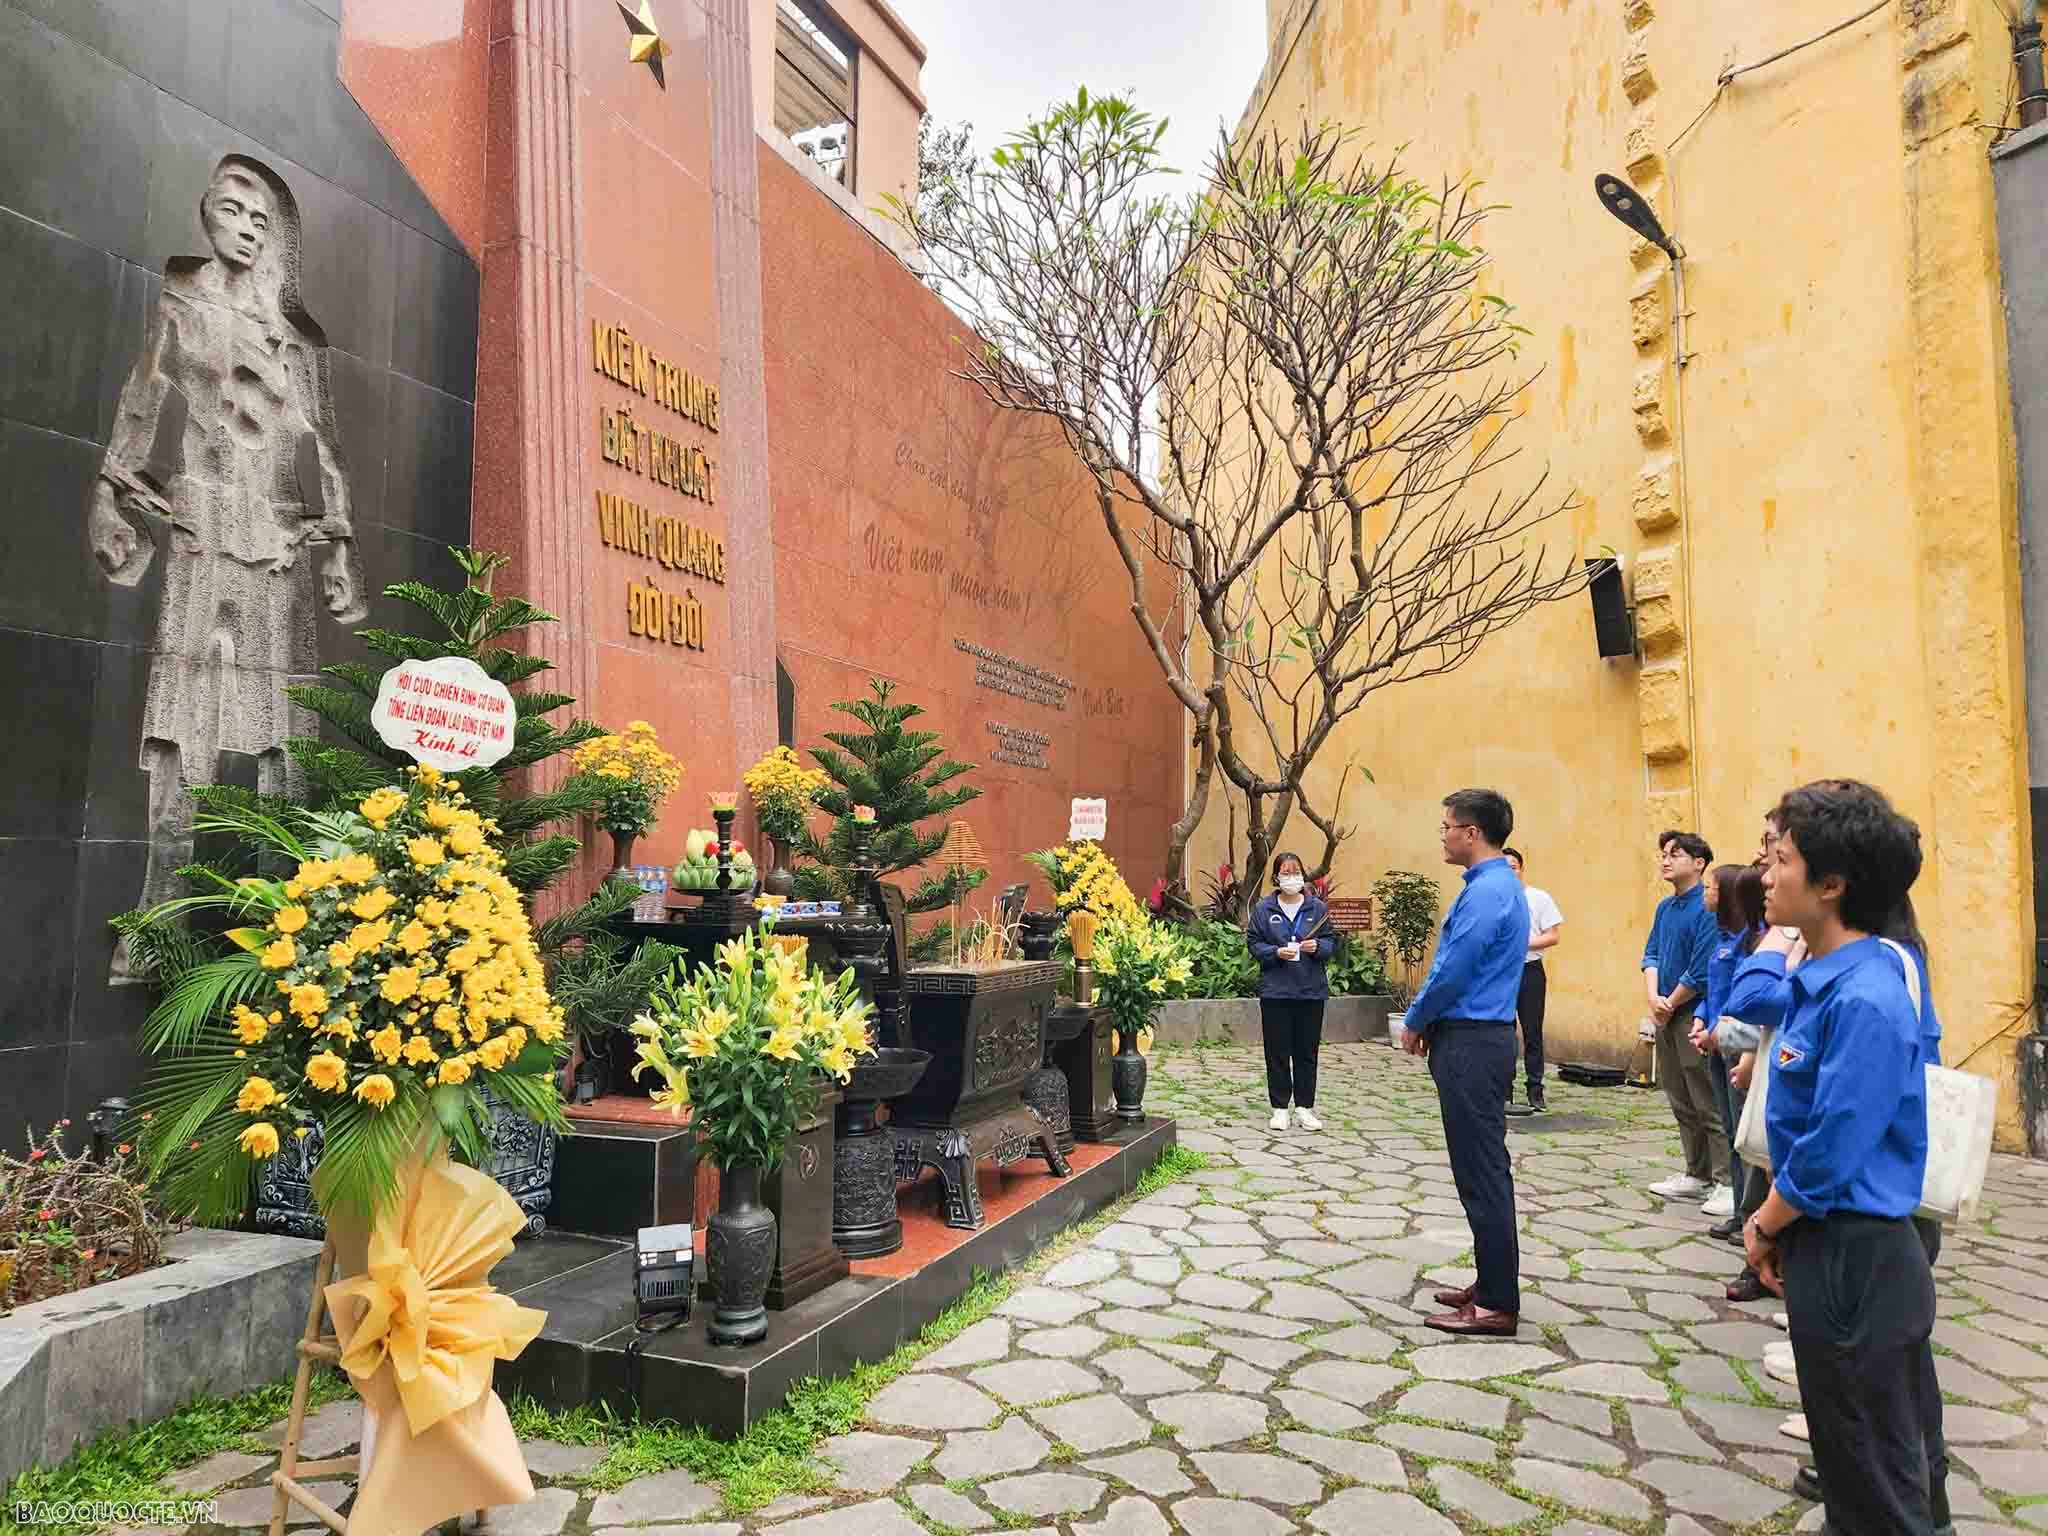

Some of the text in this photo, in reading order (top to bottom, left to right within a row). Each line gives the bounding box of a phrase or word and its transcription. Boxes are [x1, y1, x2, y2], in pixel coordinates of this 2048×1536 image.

[592, 319, 721, 434] KIÊN TRUNG
[600, 400, 718, 506] BẤT KHUẤT
[596, 489, 727, 585] VINH QUANG
[627, 575, 707, 653] ĐỜI ĐỜI
